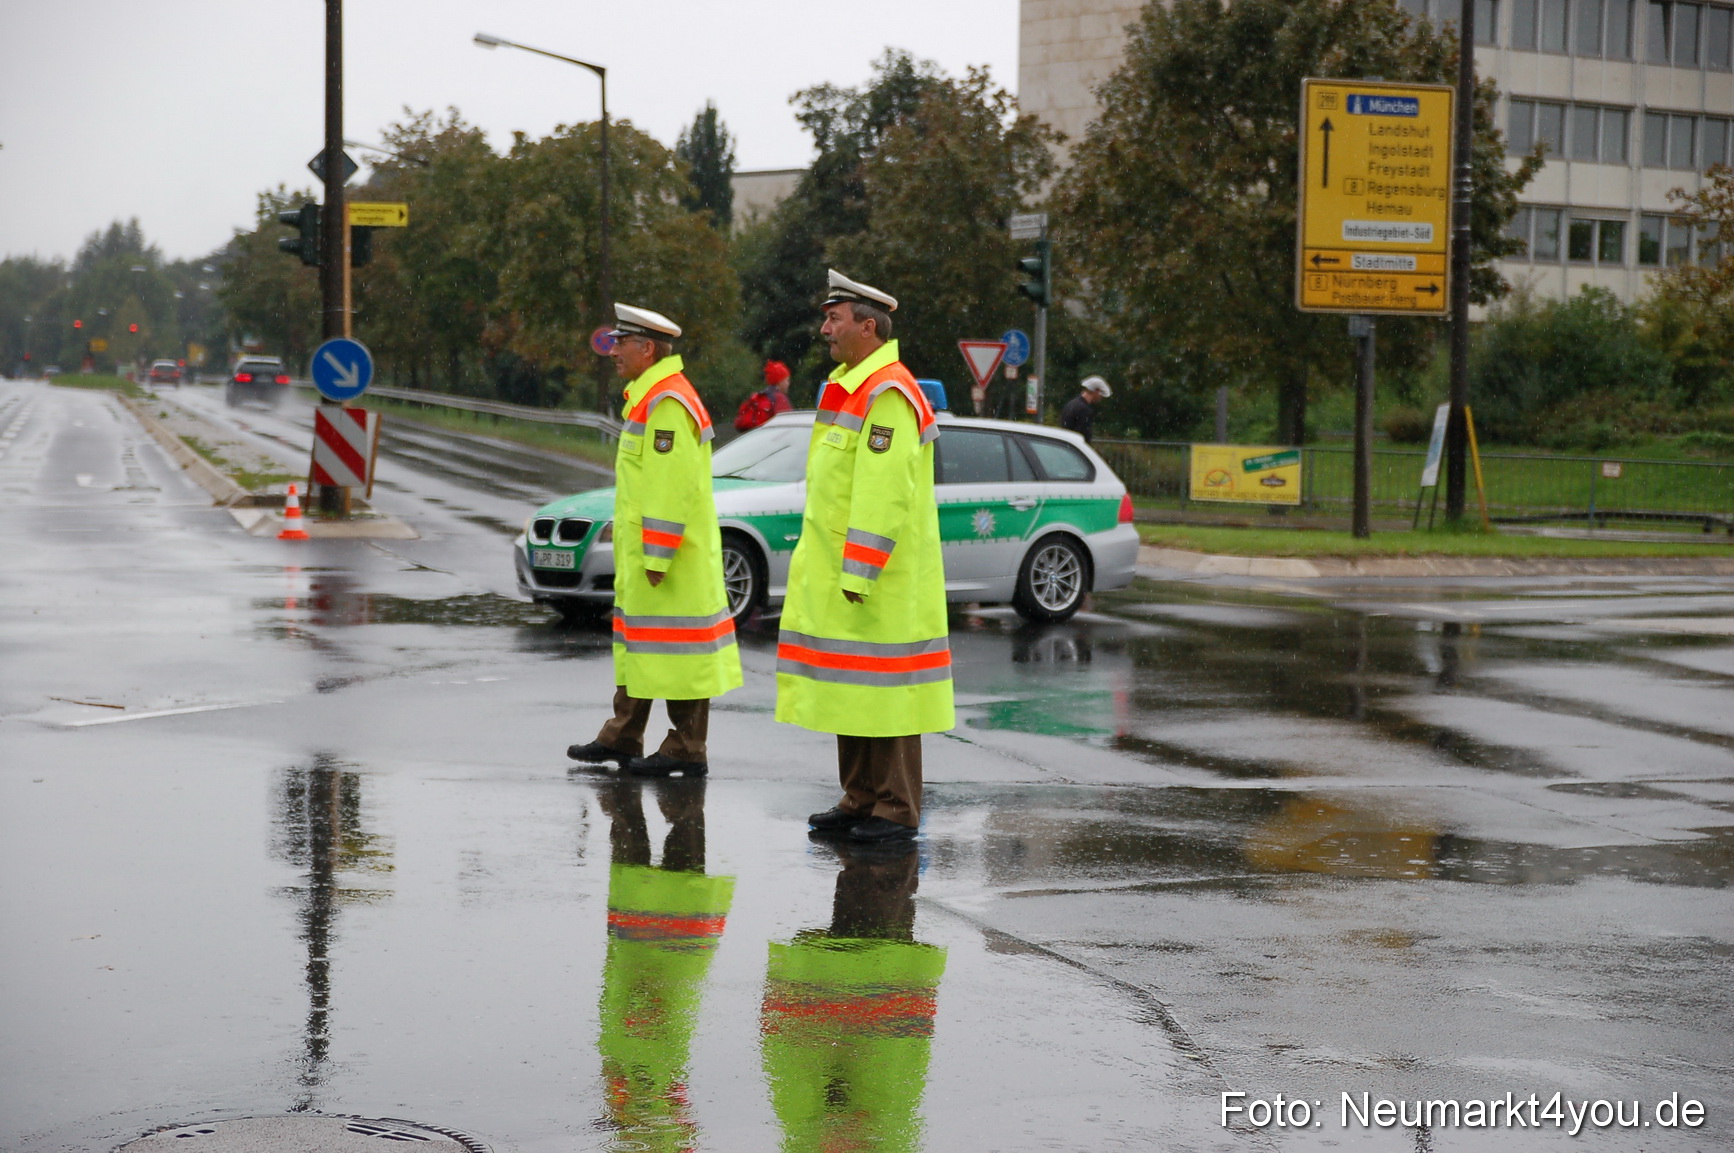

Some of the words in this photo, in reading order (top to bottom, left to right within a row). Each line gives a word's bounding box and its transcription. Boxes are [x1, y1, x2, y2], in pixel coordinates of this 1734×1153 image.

[1369, 99, 1417, 114] München
[1369, 123, 1430, 138] Landshut
[1369, 142, 1433, 159] Ingolstadt
[1368, 161, 1430, 179] Freystadt
[1367, 181, 1446, 201] Regensburg
[1366, 201, 1412, 215] Hemau
[1345, 224, 1430, 240] Industriegebiet-Süd
[1354, 256, 1413, 269] Stadtmitte
[873, 427, 891, 436] POLIZEI
[555, 553, 571, 567] 319
